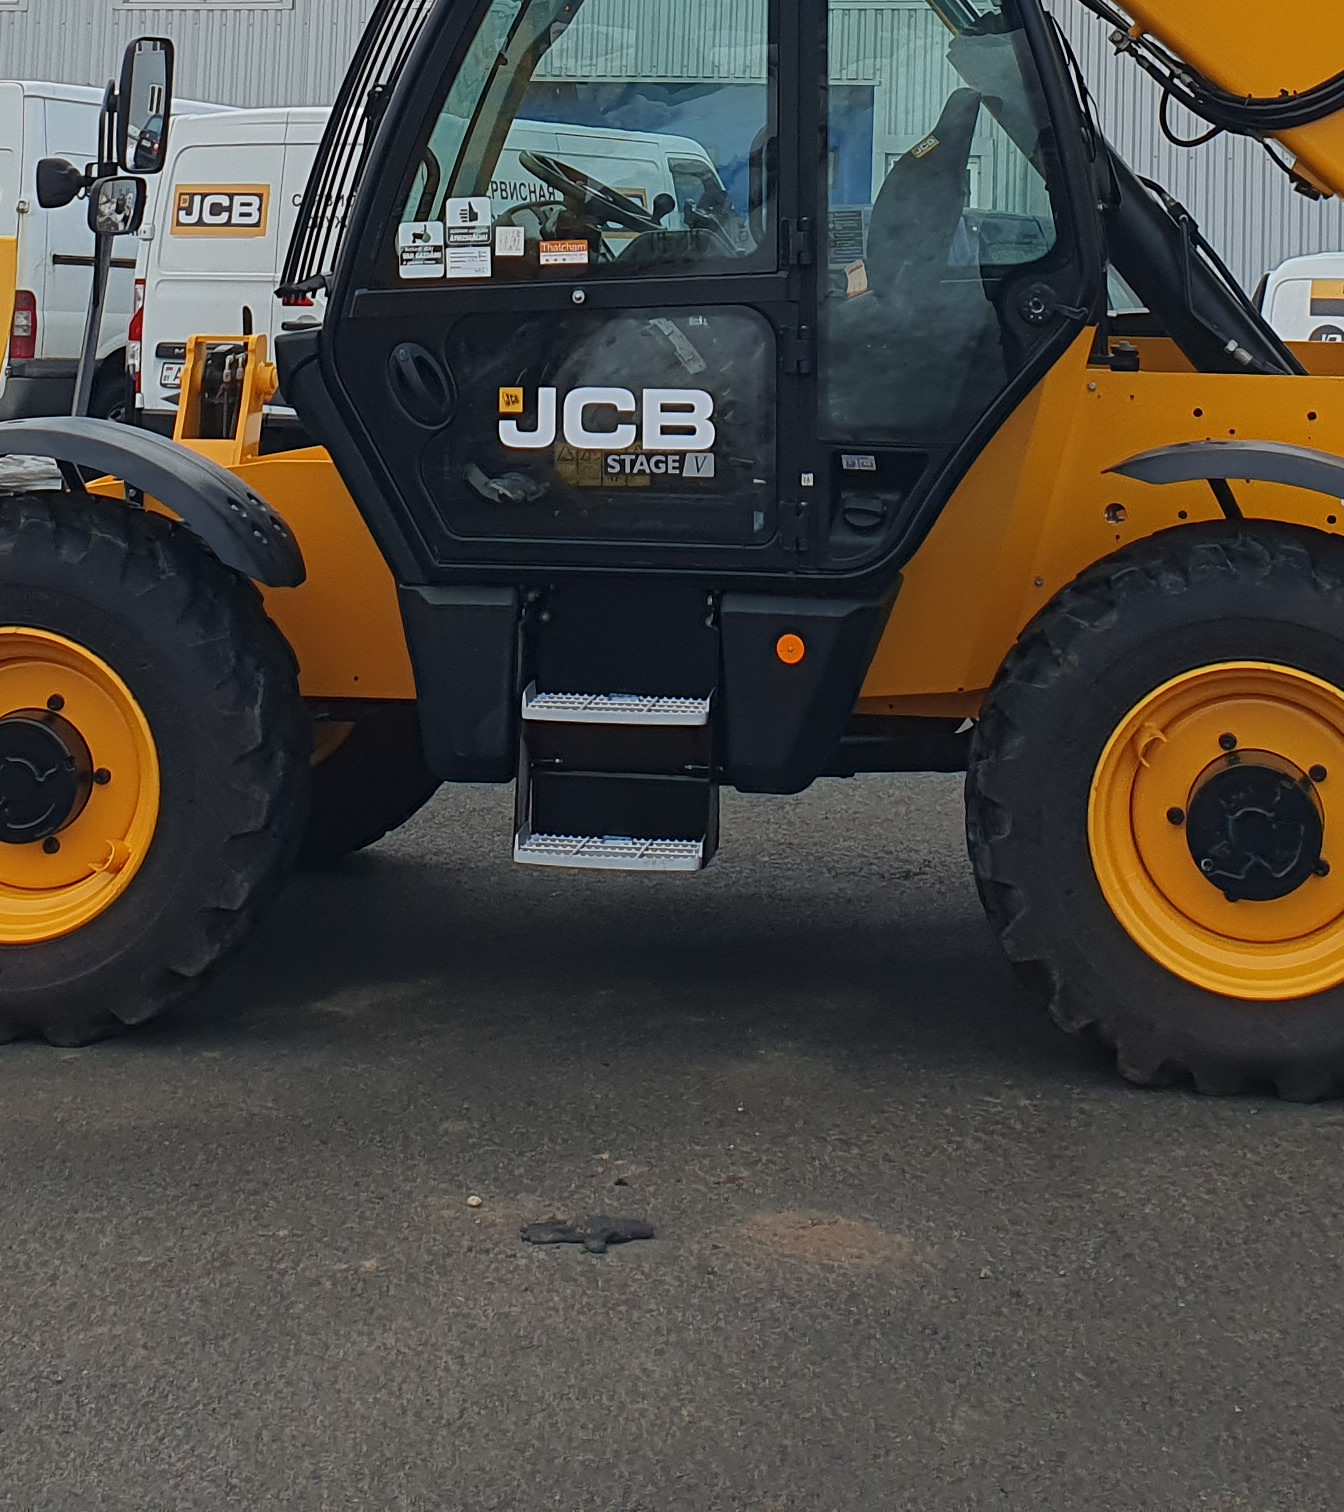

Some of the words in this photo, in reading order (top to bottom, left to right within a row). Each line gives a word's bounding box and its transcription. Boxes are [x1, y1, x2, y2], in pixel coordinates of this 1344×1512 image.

[489, 181, 556, 201] РВИСНАЯ
[178, 194, 260, 224] JCB
[540, 242, 586, 252] Thatcham
[499, 387, 716, 450] JCB
[607, 455, 680, 474] STAGE
[694, 455, 707, 474] V
